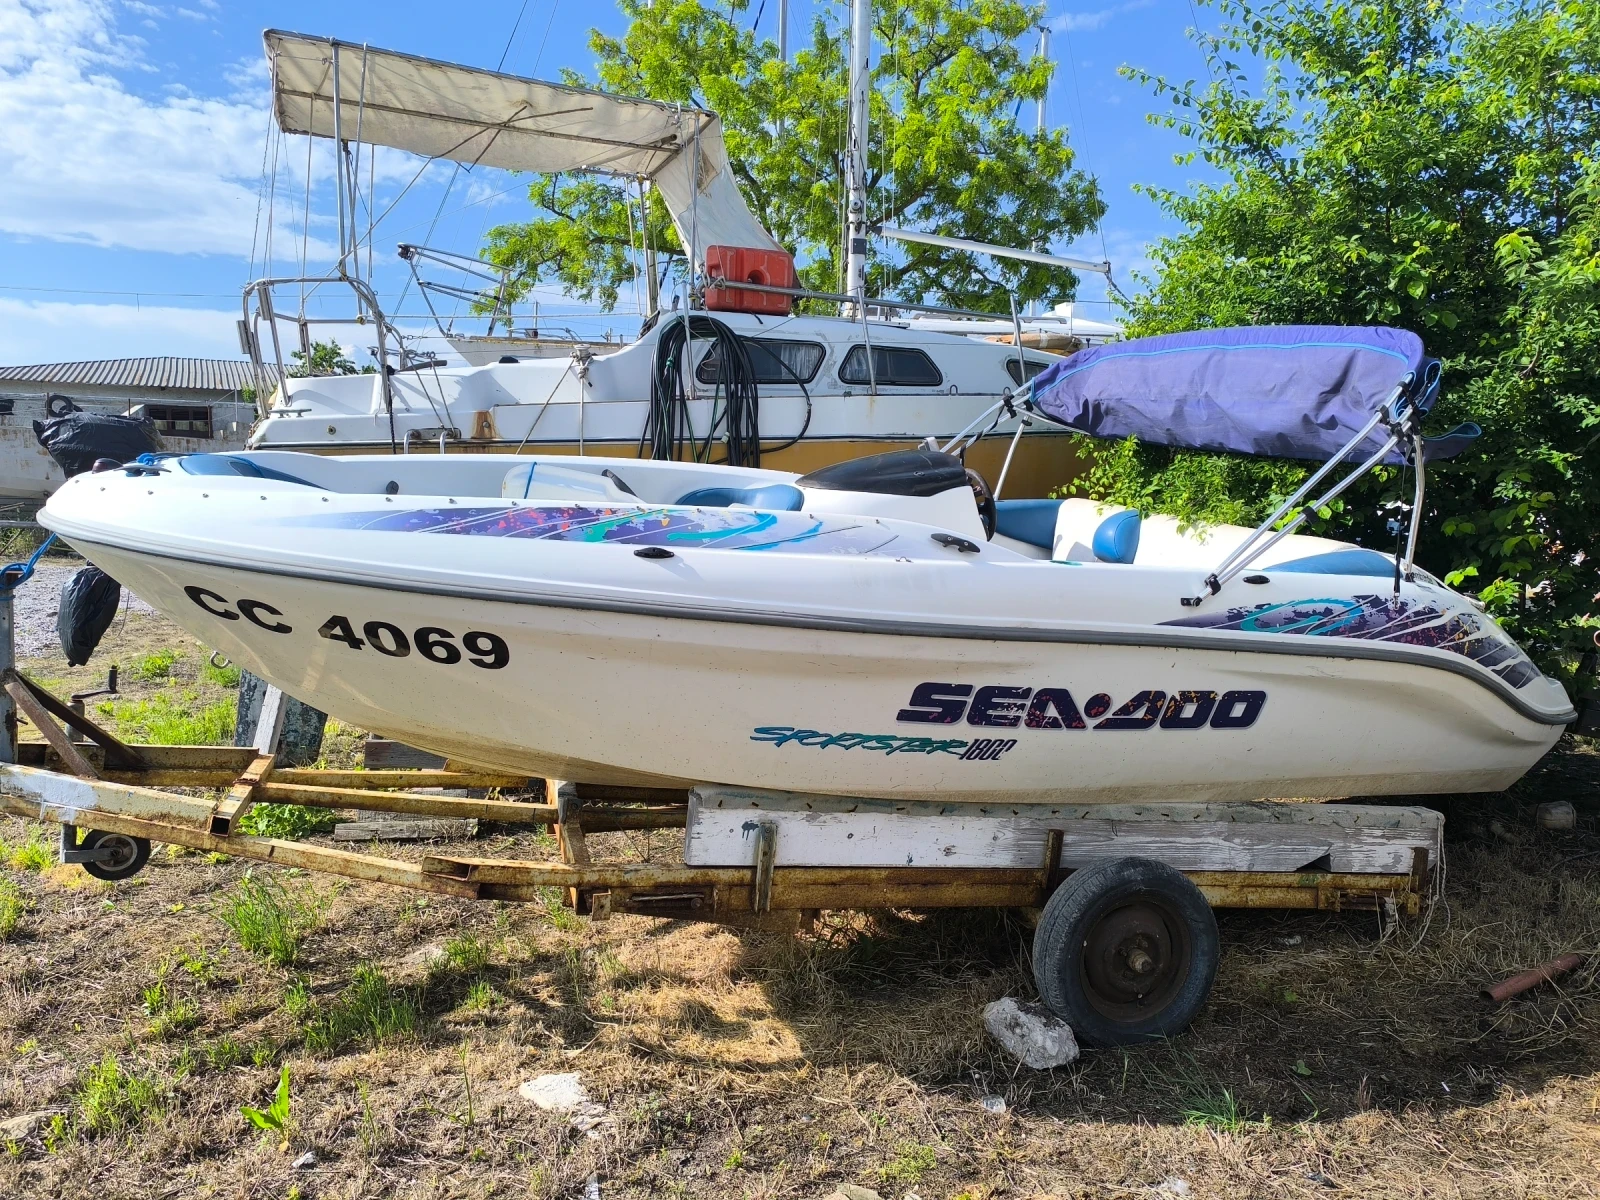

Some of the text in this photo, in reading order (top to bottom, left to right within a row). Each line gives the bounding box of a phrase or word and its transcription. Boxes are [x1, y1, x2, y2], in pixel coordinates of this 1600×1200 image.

[183, 585, 511, 670] CC 4069
[750, 726, 968, 756] SPORTSTER
